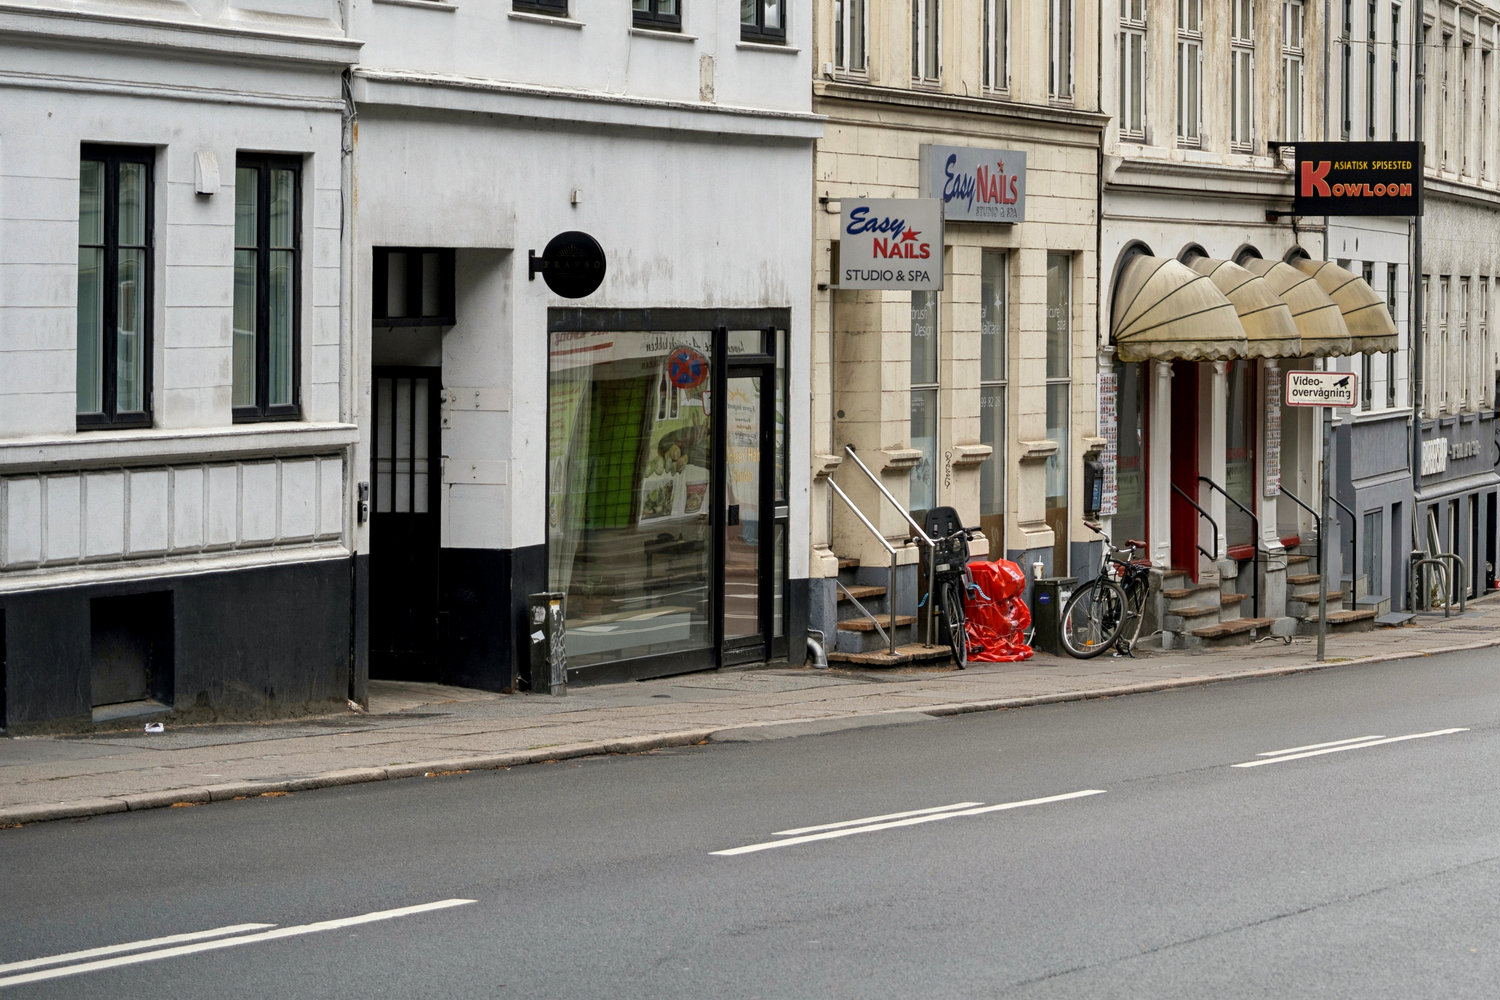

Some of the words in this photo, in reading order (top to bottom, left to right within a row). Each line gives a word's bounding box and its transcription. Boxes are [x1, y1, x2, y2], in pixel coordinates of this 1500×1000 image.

[1333, 161, 1369, 170] ASIATISK
[1372, 161, 1412, 170] SPISESTED
[943, 153, 976, 213] Easy
[976, 164, 1018, 205] NAILS
[1301, 160, 1412, 198] KOWLOON
[975, 206, 998, 217] STUDIO
[1006, 207, 1018, 218] SPA
[846, 206, 906, 240] Easy
[873, 237, 930, 259] NAILS
[845, 269, 893, 281] STUDIO
[896, 269, 905, 281] &
[908, 270, 931, 282] SPA
[911, 306, 928, 320] brush
[1046, 307, 1060, 319] icure
[1293, 376, 1324, 386] Video-
[1292, 387, 1351, 400] overvågning
